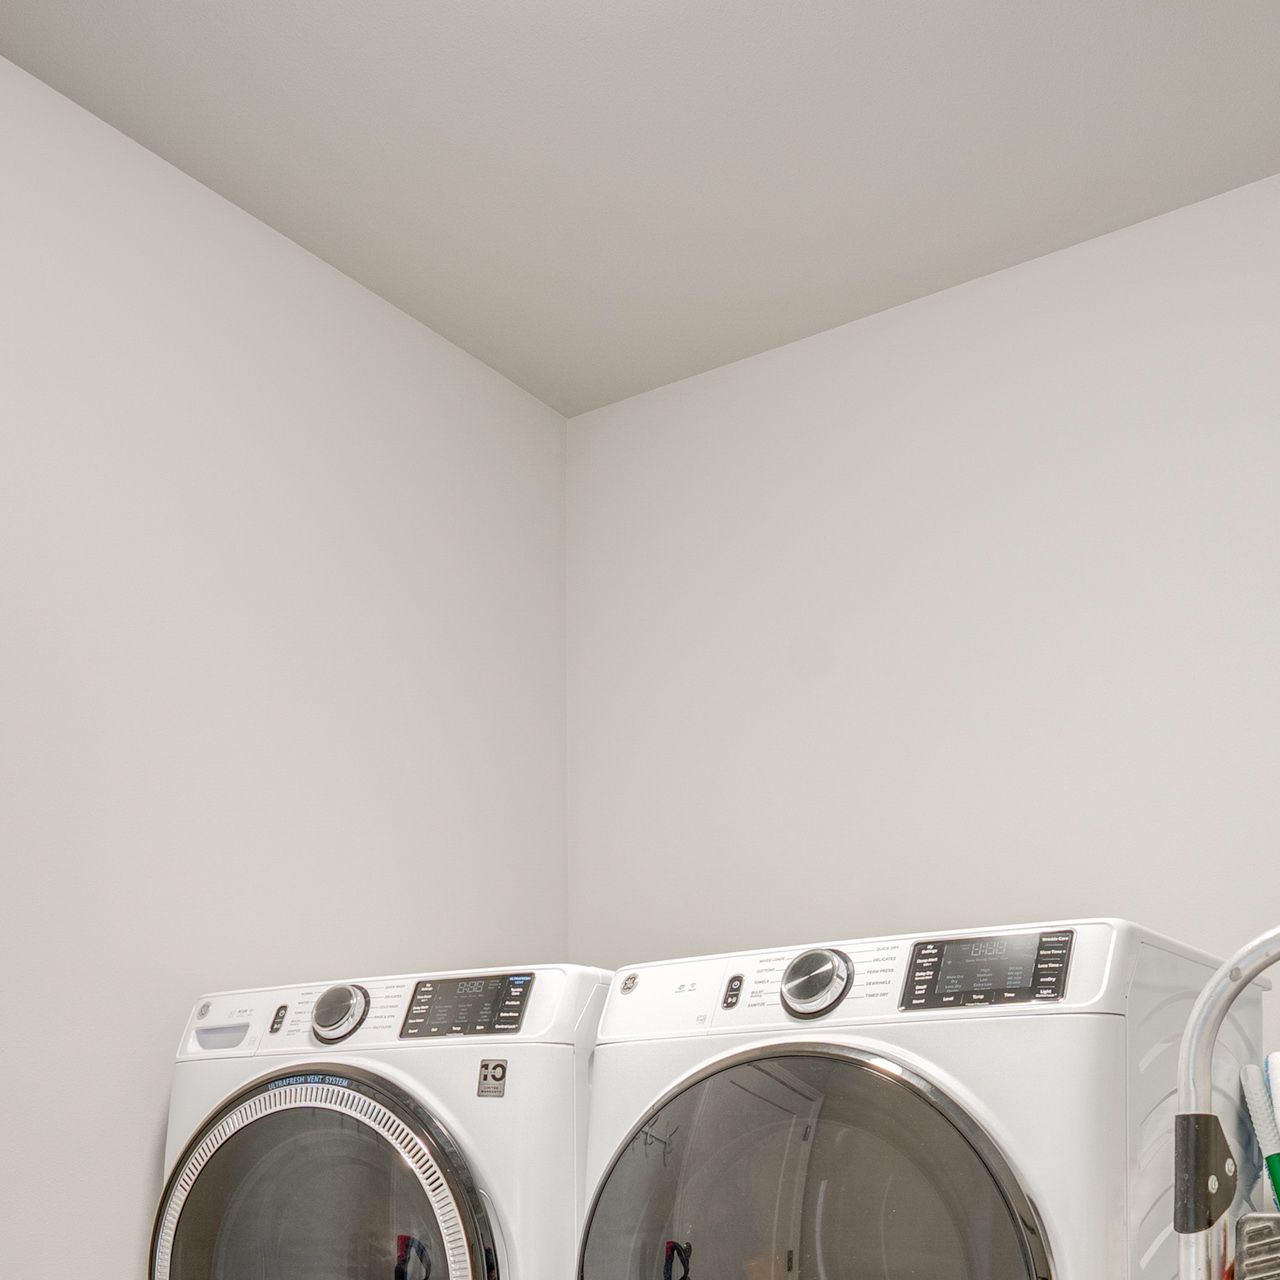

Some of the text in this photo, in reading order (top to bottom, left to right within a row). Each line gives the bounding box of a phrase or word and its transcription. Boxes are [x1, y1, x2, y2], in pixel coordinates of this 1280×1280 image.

[481, 1063, 506, 1082] 10
[268, 1075, 349, 1090] ULTRAFRESH VENT SYSTEM
